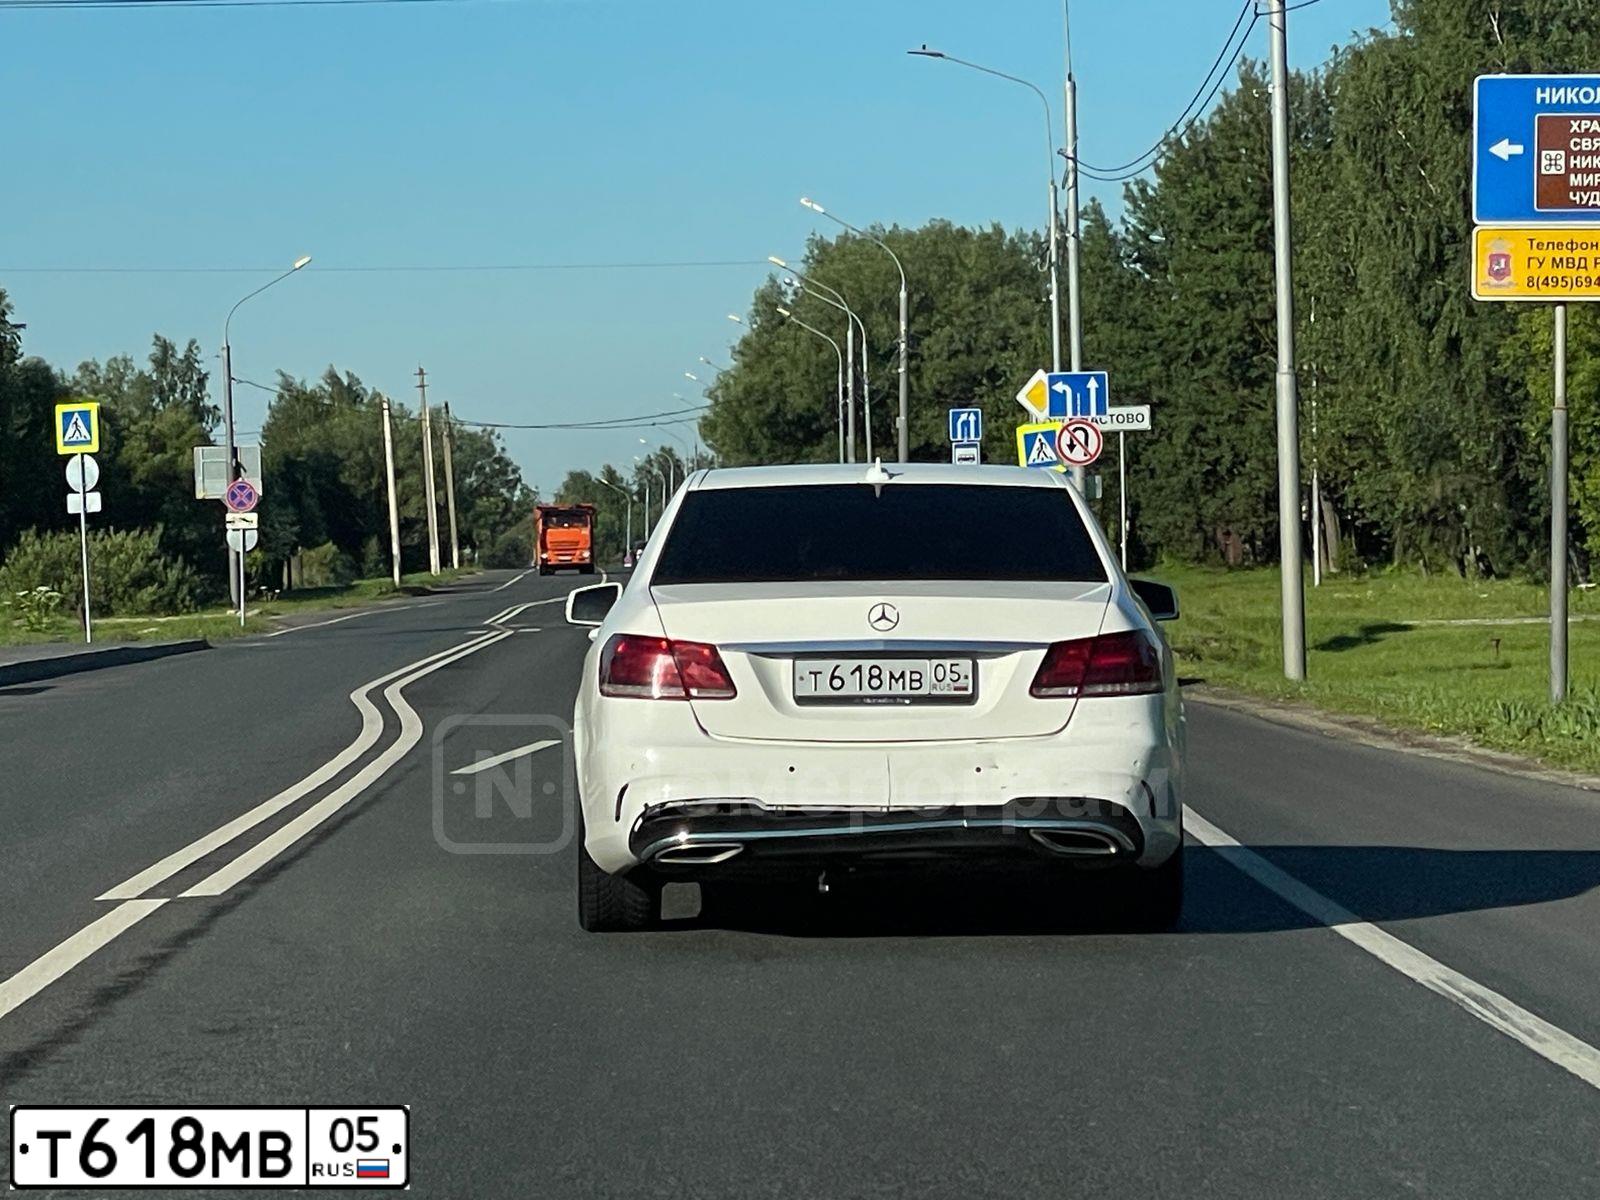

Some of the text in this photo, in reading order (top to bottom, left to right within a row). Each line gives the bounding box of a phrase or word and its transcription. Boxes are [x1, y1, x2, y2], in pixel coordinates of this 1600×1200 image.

[1526, 237, 1599, 253] Телефон
[1527, 256, 1546, 269] ГУ
[1551, 256, 1588, 271] МВД
[1526, 275, 1600, 291] 8(495)694
[808, 663, 961, 692] Т618МВ 05
[931, 683, 952, 692] RUS
